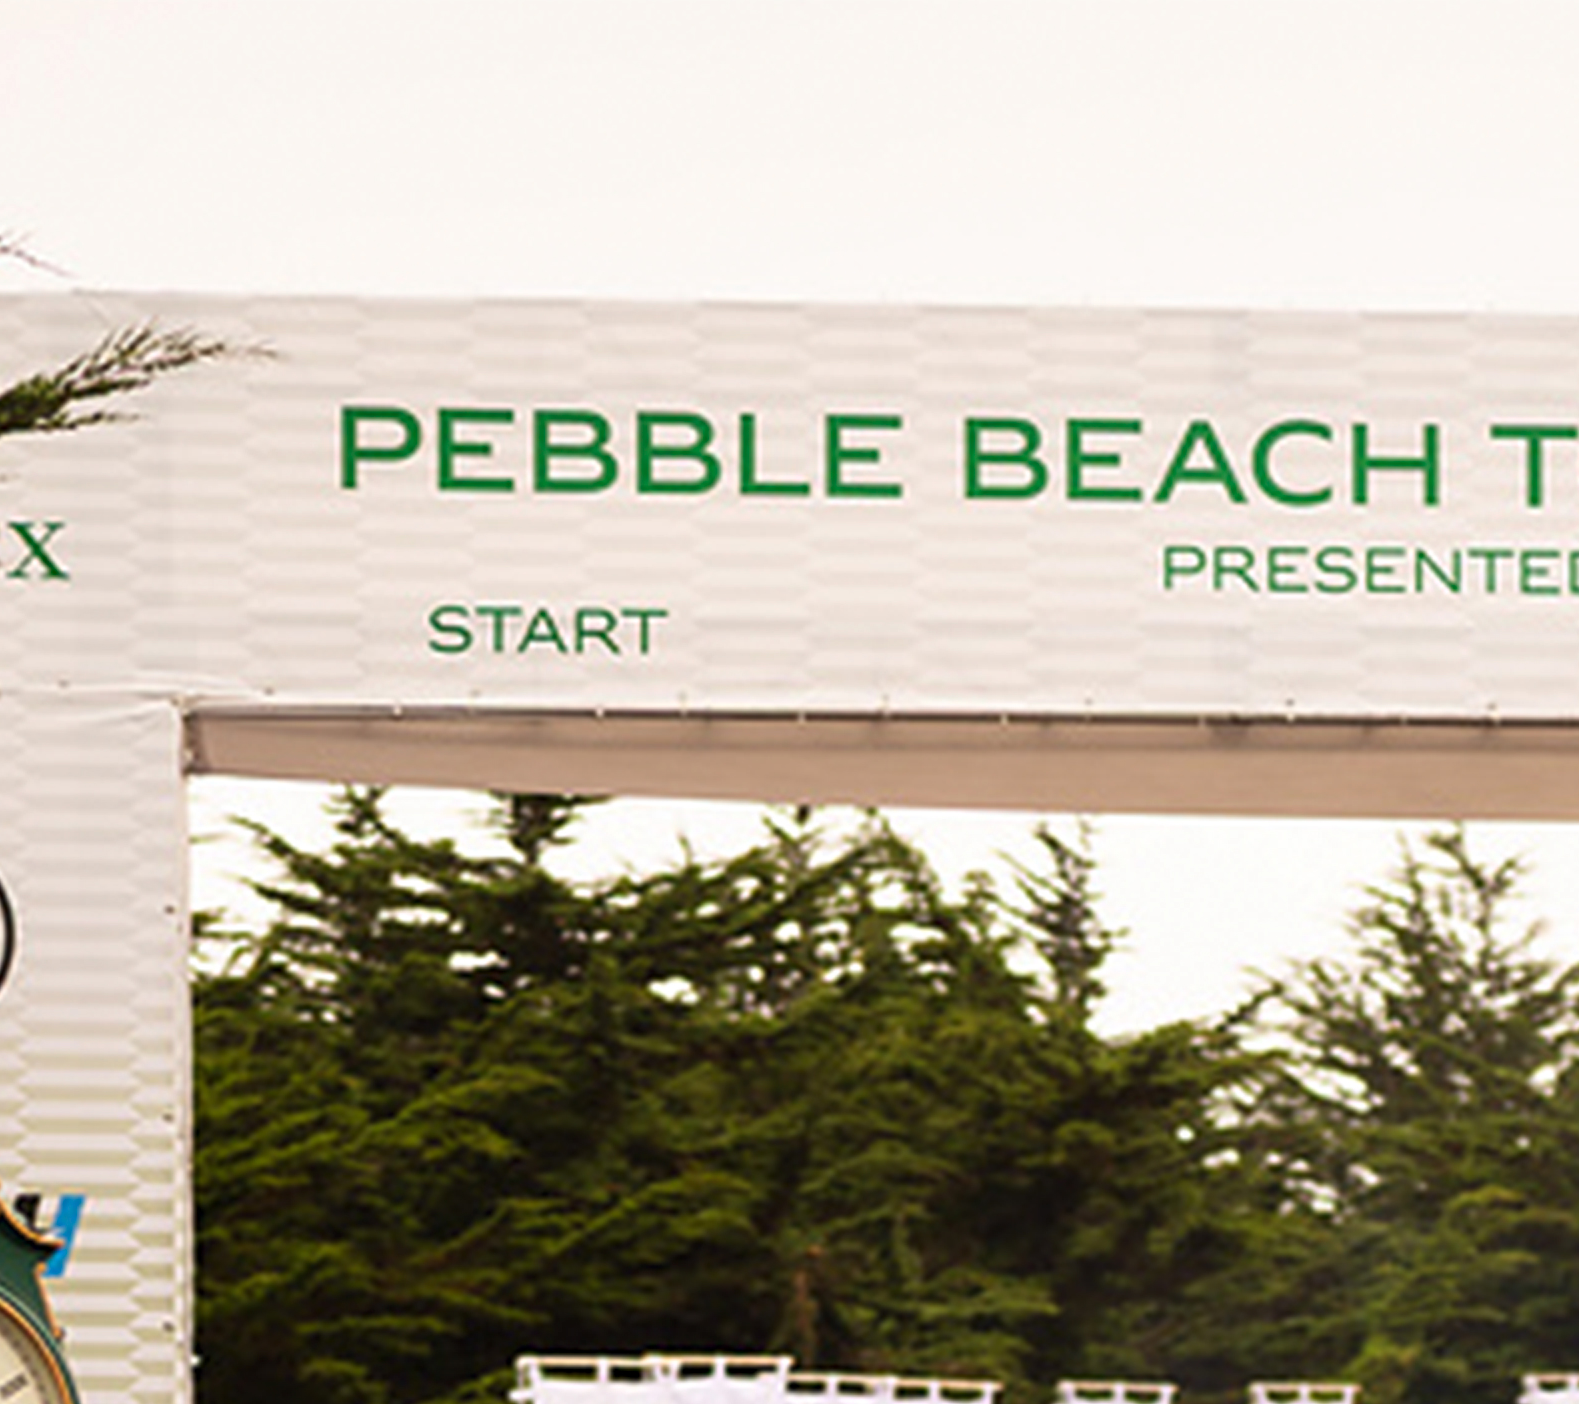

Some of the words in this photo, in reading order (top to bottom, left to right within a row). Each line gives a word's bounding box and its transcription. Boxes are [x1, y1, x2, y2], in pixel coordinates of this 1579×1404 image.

[339, 405, 904, 500] PEBBLE
[963, 416, 1441, 510] BEACH
[427, 603, 669, 655] START
